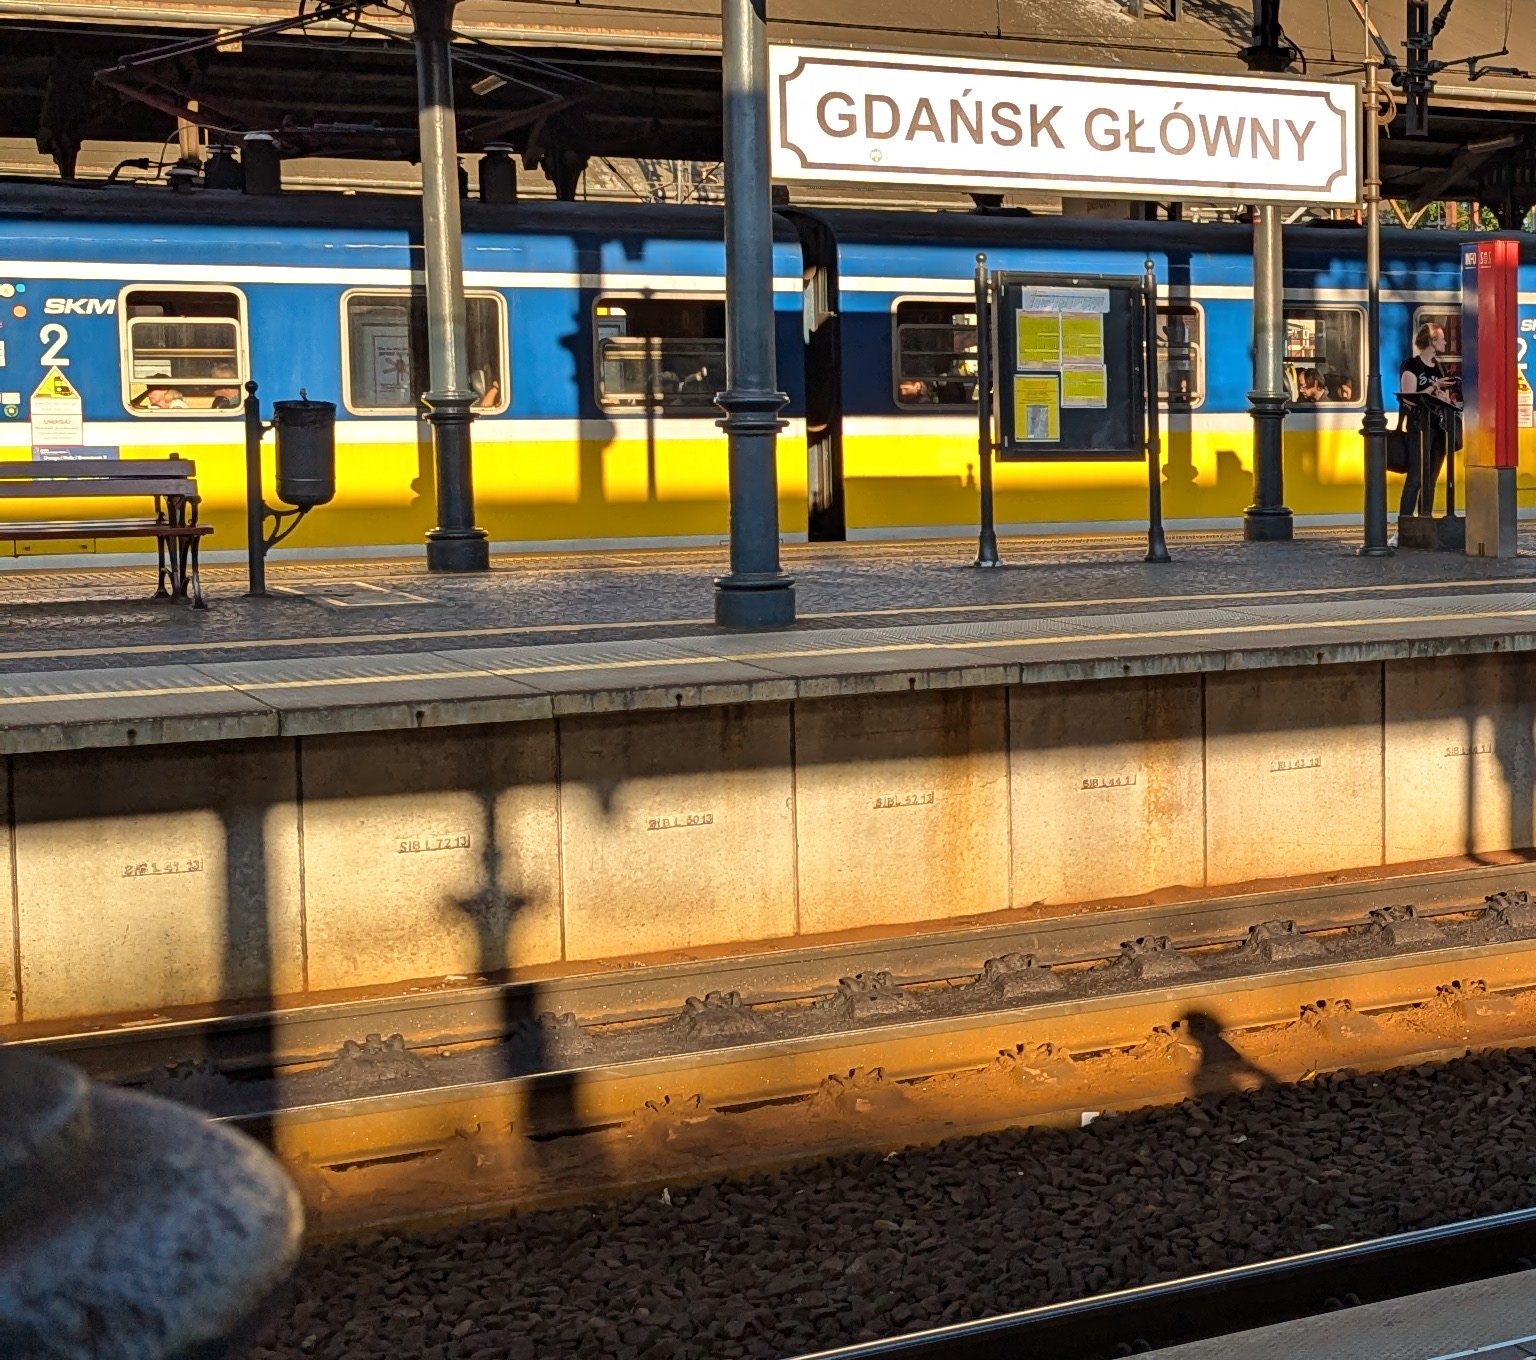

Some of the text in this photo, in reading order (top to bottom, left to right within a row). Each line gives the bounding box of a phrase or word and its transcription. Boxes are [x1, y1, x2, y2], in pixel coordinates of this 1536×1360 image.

[816, 88, 1316, 162] GDAŃSK GŁÓWNY
[43, 298, 116, 315] SKM
[39, 323, 70, 366] 2
[400, 840, 420, 852] SIB
[437, 838, 451, 849] 72
